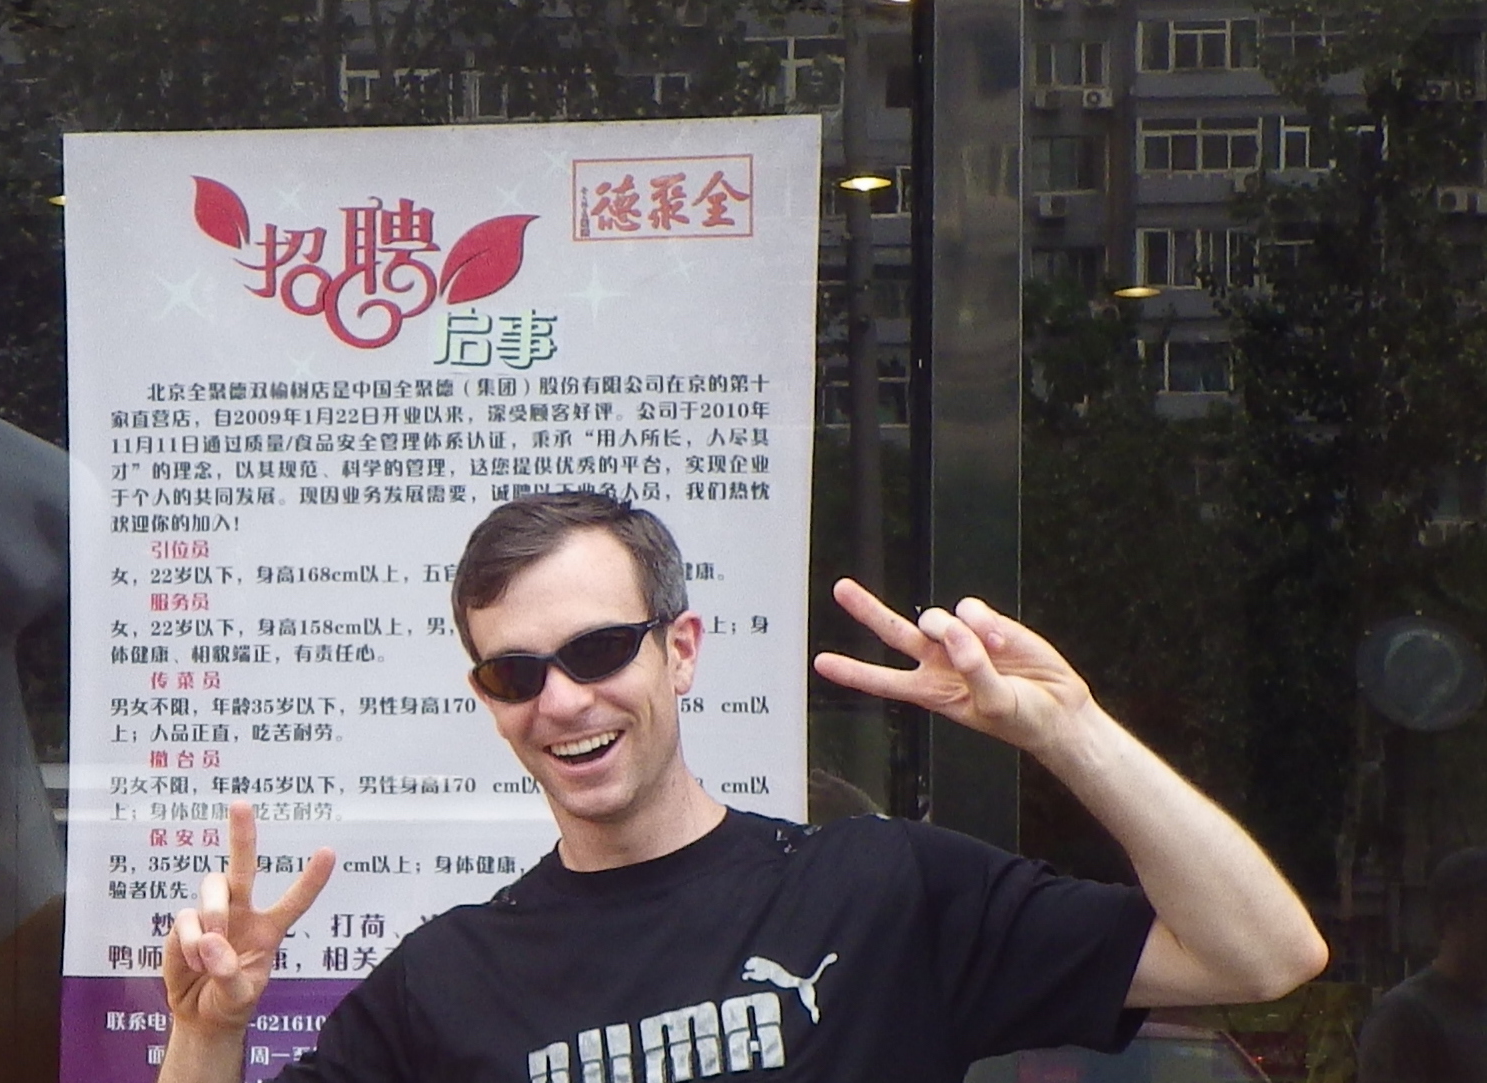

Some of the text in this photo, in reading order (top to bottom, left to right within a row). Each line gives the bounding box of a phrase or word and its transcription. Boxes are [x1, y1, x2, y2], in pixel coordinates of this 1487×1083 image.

[233, 196, 441, 349] 招聘
[434, 308, 558, 370] 启事
[151, 539, 210, 560] 引位员
[150, 592, 210, 612] 服务员
[110, 801, 344, 822] 上；身体健康吃苦耐劳。
[106, 1010, 174, 1032] 联系电
